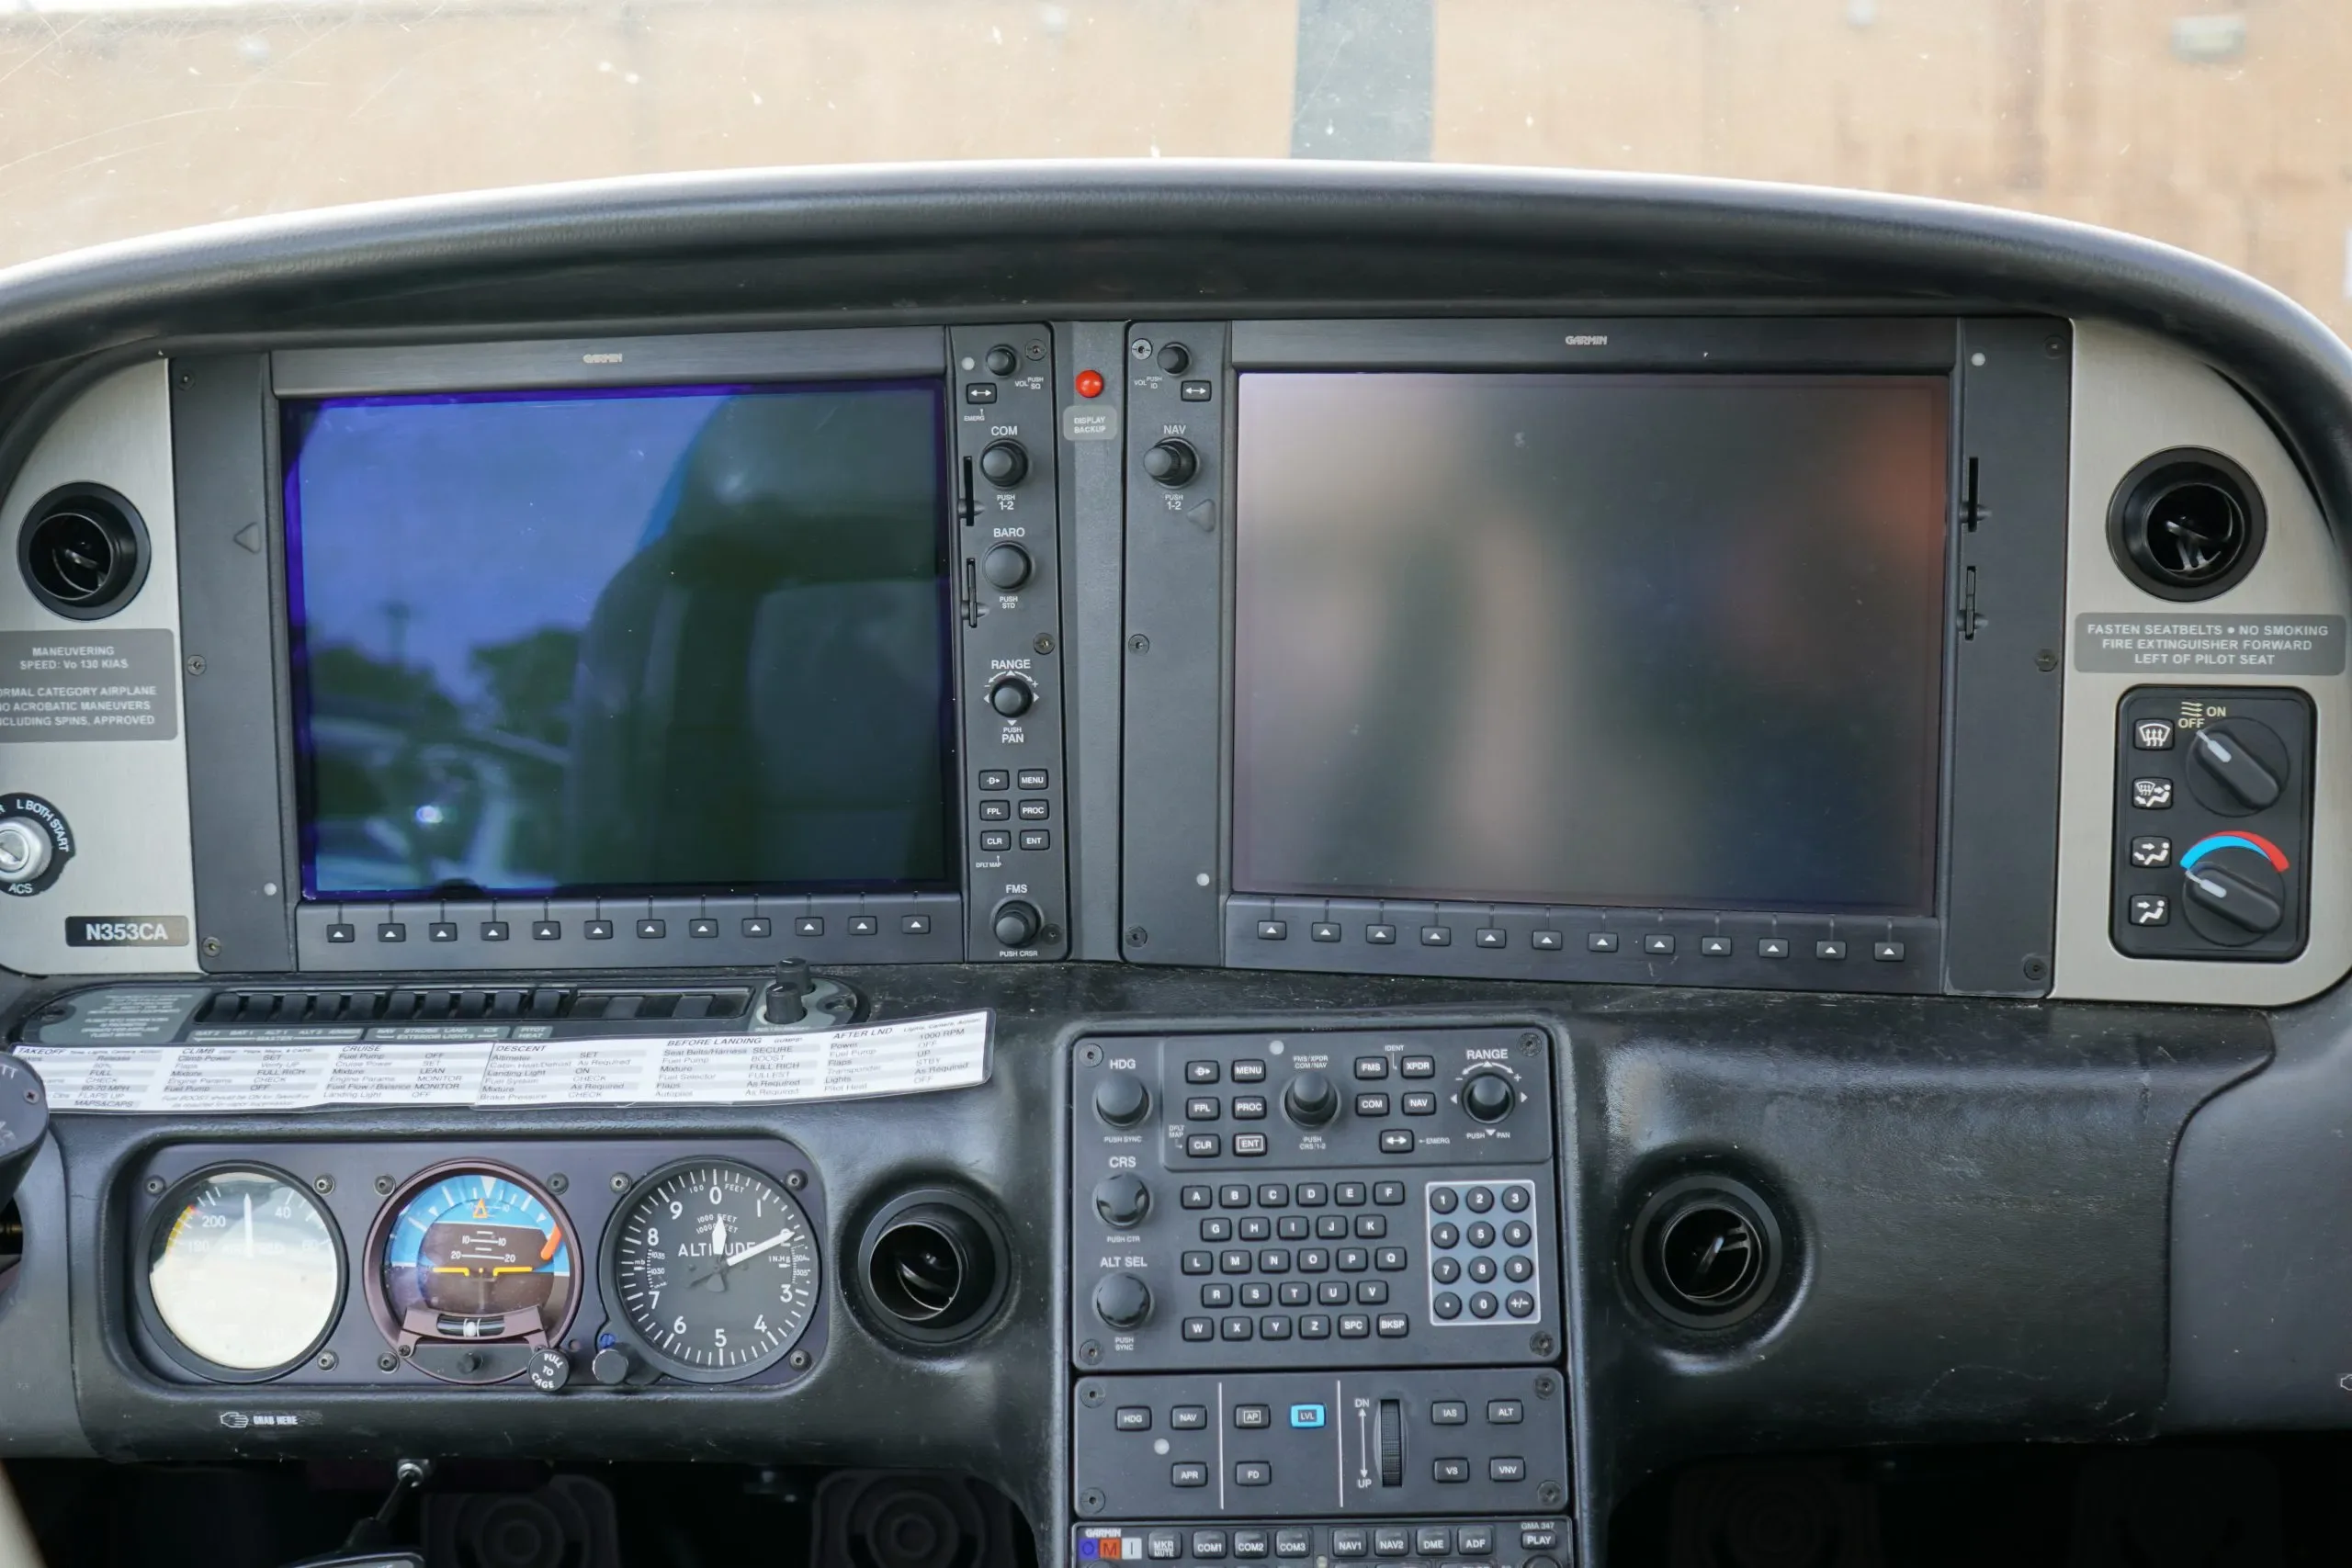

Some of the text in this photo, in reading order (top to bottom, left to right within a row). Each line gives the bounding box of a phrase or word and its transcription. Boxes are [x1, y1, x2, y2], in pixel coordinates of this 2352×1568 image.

[1565, 334, 1608, 345] GARMIN
[990, 426, 1018, 436] COM
[1074, 425, 1106, 434] BACKUP
[1163, 425, 1186, 434] NAV
[999, 501, 1014, 511] 1-2
[1167, 501, 1182, 511] 1-2
[993, 527, 1025, 537] BARO
[2087, 625, 2329, 636] FASTEN SEATBELTS NO SMOKING
[2102, 639, 2312, 650] FIRE EXTINGUISHER FORWARD
[32, 647, 114, 656] MANEUVERING
[20, 660, 61, 670] SPEED:
[63, 660, 77, 670] Vo
[101, 659, 129, 669] KIAS
[2134, 654, 2276, 665] LEFT OF PILOT SEAT
[991, 660, 1031, 670] RANGE
[37, 687, 96, 697] CATEGORY
[100, 686, 157, 696] AIRPLANE
[14, 701, 151, 712] ACROBATIC MANEUVERS
[2206, 706, 2226, 716] ON
[0, 716, 51, 727] CLUDING
[94, 716, 155, 725] APPROVED
[2177, 718, 2205, 728] OFF
[1001, 733, 1024, 743] PAN
[25, 799, 69, 852] BOTH START
[8, 883, 33, 894] ACS
[1006, 885, 1028, 894] FMS
[85, 923, 168, 941] N353CA
[943, 1029, 965, 1037] RPM
[1466, 1049, 1508, 1060] RANGE
[1110, 1059, 1136, 1070] HDG
[1362, 1063, 1381, 1072] FMS
[1406, 1062, 1430, 1070] XPDR
[1236, 1066, 1262, 1075] MENU
[1194, 1104, 1211, 1112] FPL
[1237, 1103, 1262, 1111] PROC
[1362, 1100, 1383, 1109] COM
[1409, 1100, 1429, 1108] NAV
[1193, 1141, 1212, 1149] CLR
[1241, 1139, 1260, 1148] ENT
[1109, 1156, 1136, 1168] CRS
[689, 1184, 745, 1193] 100 FEET
[709, 1186, 722, 1204] 0
[275, 1206, 292, 1220] 40
[670, 1201, 684, 1220] 9
[201, 1215, 226, 1228] 200
[462, 1235, 506, 1247] 10 10
[647, 1227, 660, 1246] 8
[450, 1250, 515, 1263] 20 20
[1100, 1257, 1148, 1268] ALT SEL
[780, 1284, 793, 1303] 3
[649, 1291, 660, 1310] 7
[673, 1315, 686, 1334] 6
[753, 1314, 767, 1332] 4
[1344, 1321, 1363, 1330] SPC
[1381, 1320, 1405, 1329] BKSP
[715, 1329, 727, 1348] 5
[544, 1353, 563, 1369] PULL
[542, 1365, 554, 1376] TO
[531, 1373, 555, 1389] CAGE
[1355, 1398, 1370, 1408] DN
[1247, 1413, 1259, 1421] AP
[1300, 1412, 1314, 1420] LVL
[1443, 1408, 1457, 1417] IAS
[1498, 1408, 1513, 1416] ALT
[1124, 1415, 1143, 1423] HDG
[1180, 1414, 1197, 1422] NAV
[1248, 1471, 1260, 1479] FD
[1446, 1467, 1458, 1475] VS
[1498, 1466, 1517, 1474] VNV
[1181, 1471, 1199, 1480] APR
[1358, 1479, 1372, 1488] UP
[1085, 1529, 1122, 1538] GARMIN
[1154, 1540, 1174, 1550] MKR
[1380, 1540, 1404, 1549] NAV2
[1424, 1540, 1444, 1549] DME
[1466, 1540, 1486, 1549] ADF
[1527, 1536, 1551, 1545] PLAY
[1198, 1543, 1222, 1552] COM1
[1238, 1543, 1264, 1551] COM2
[1280, 1542, 1306, 1551] COM3
[1339, 1541, 1362, 1551] NAV1
